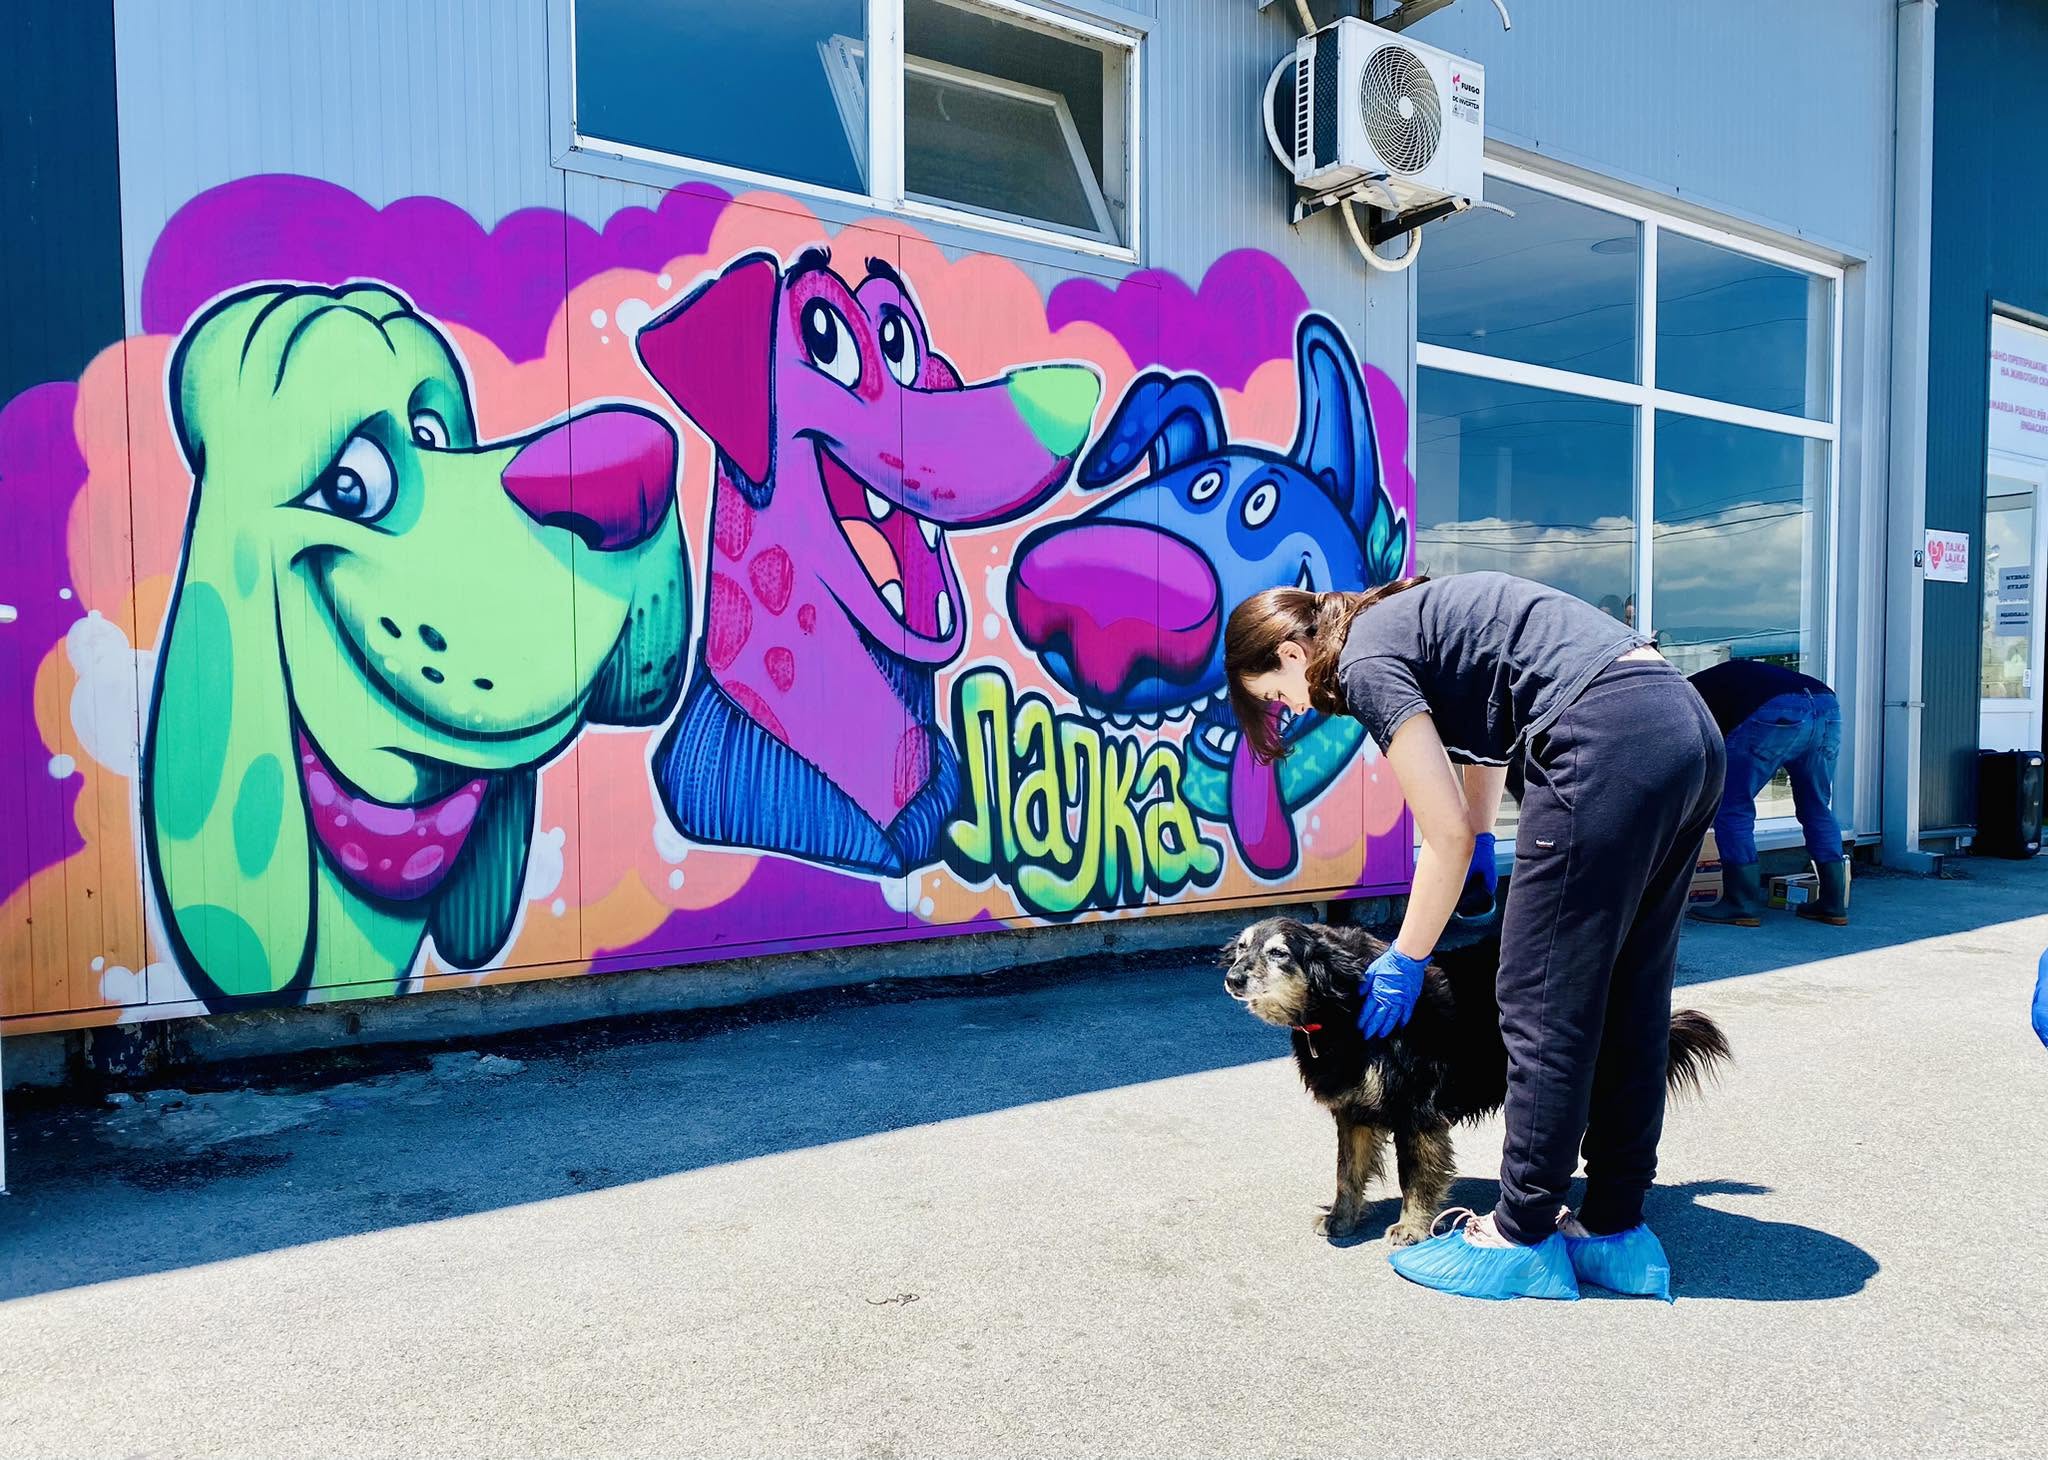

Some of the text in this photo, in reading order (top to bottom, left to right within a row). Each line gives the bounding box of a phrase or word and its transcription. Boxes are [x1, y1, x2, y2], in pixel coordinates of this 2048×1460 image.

[1461, 82, 1480, 94] FUEGO
[1452, 95, 1480, 110] DC INVERTER
